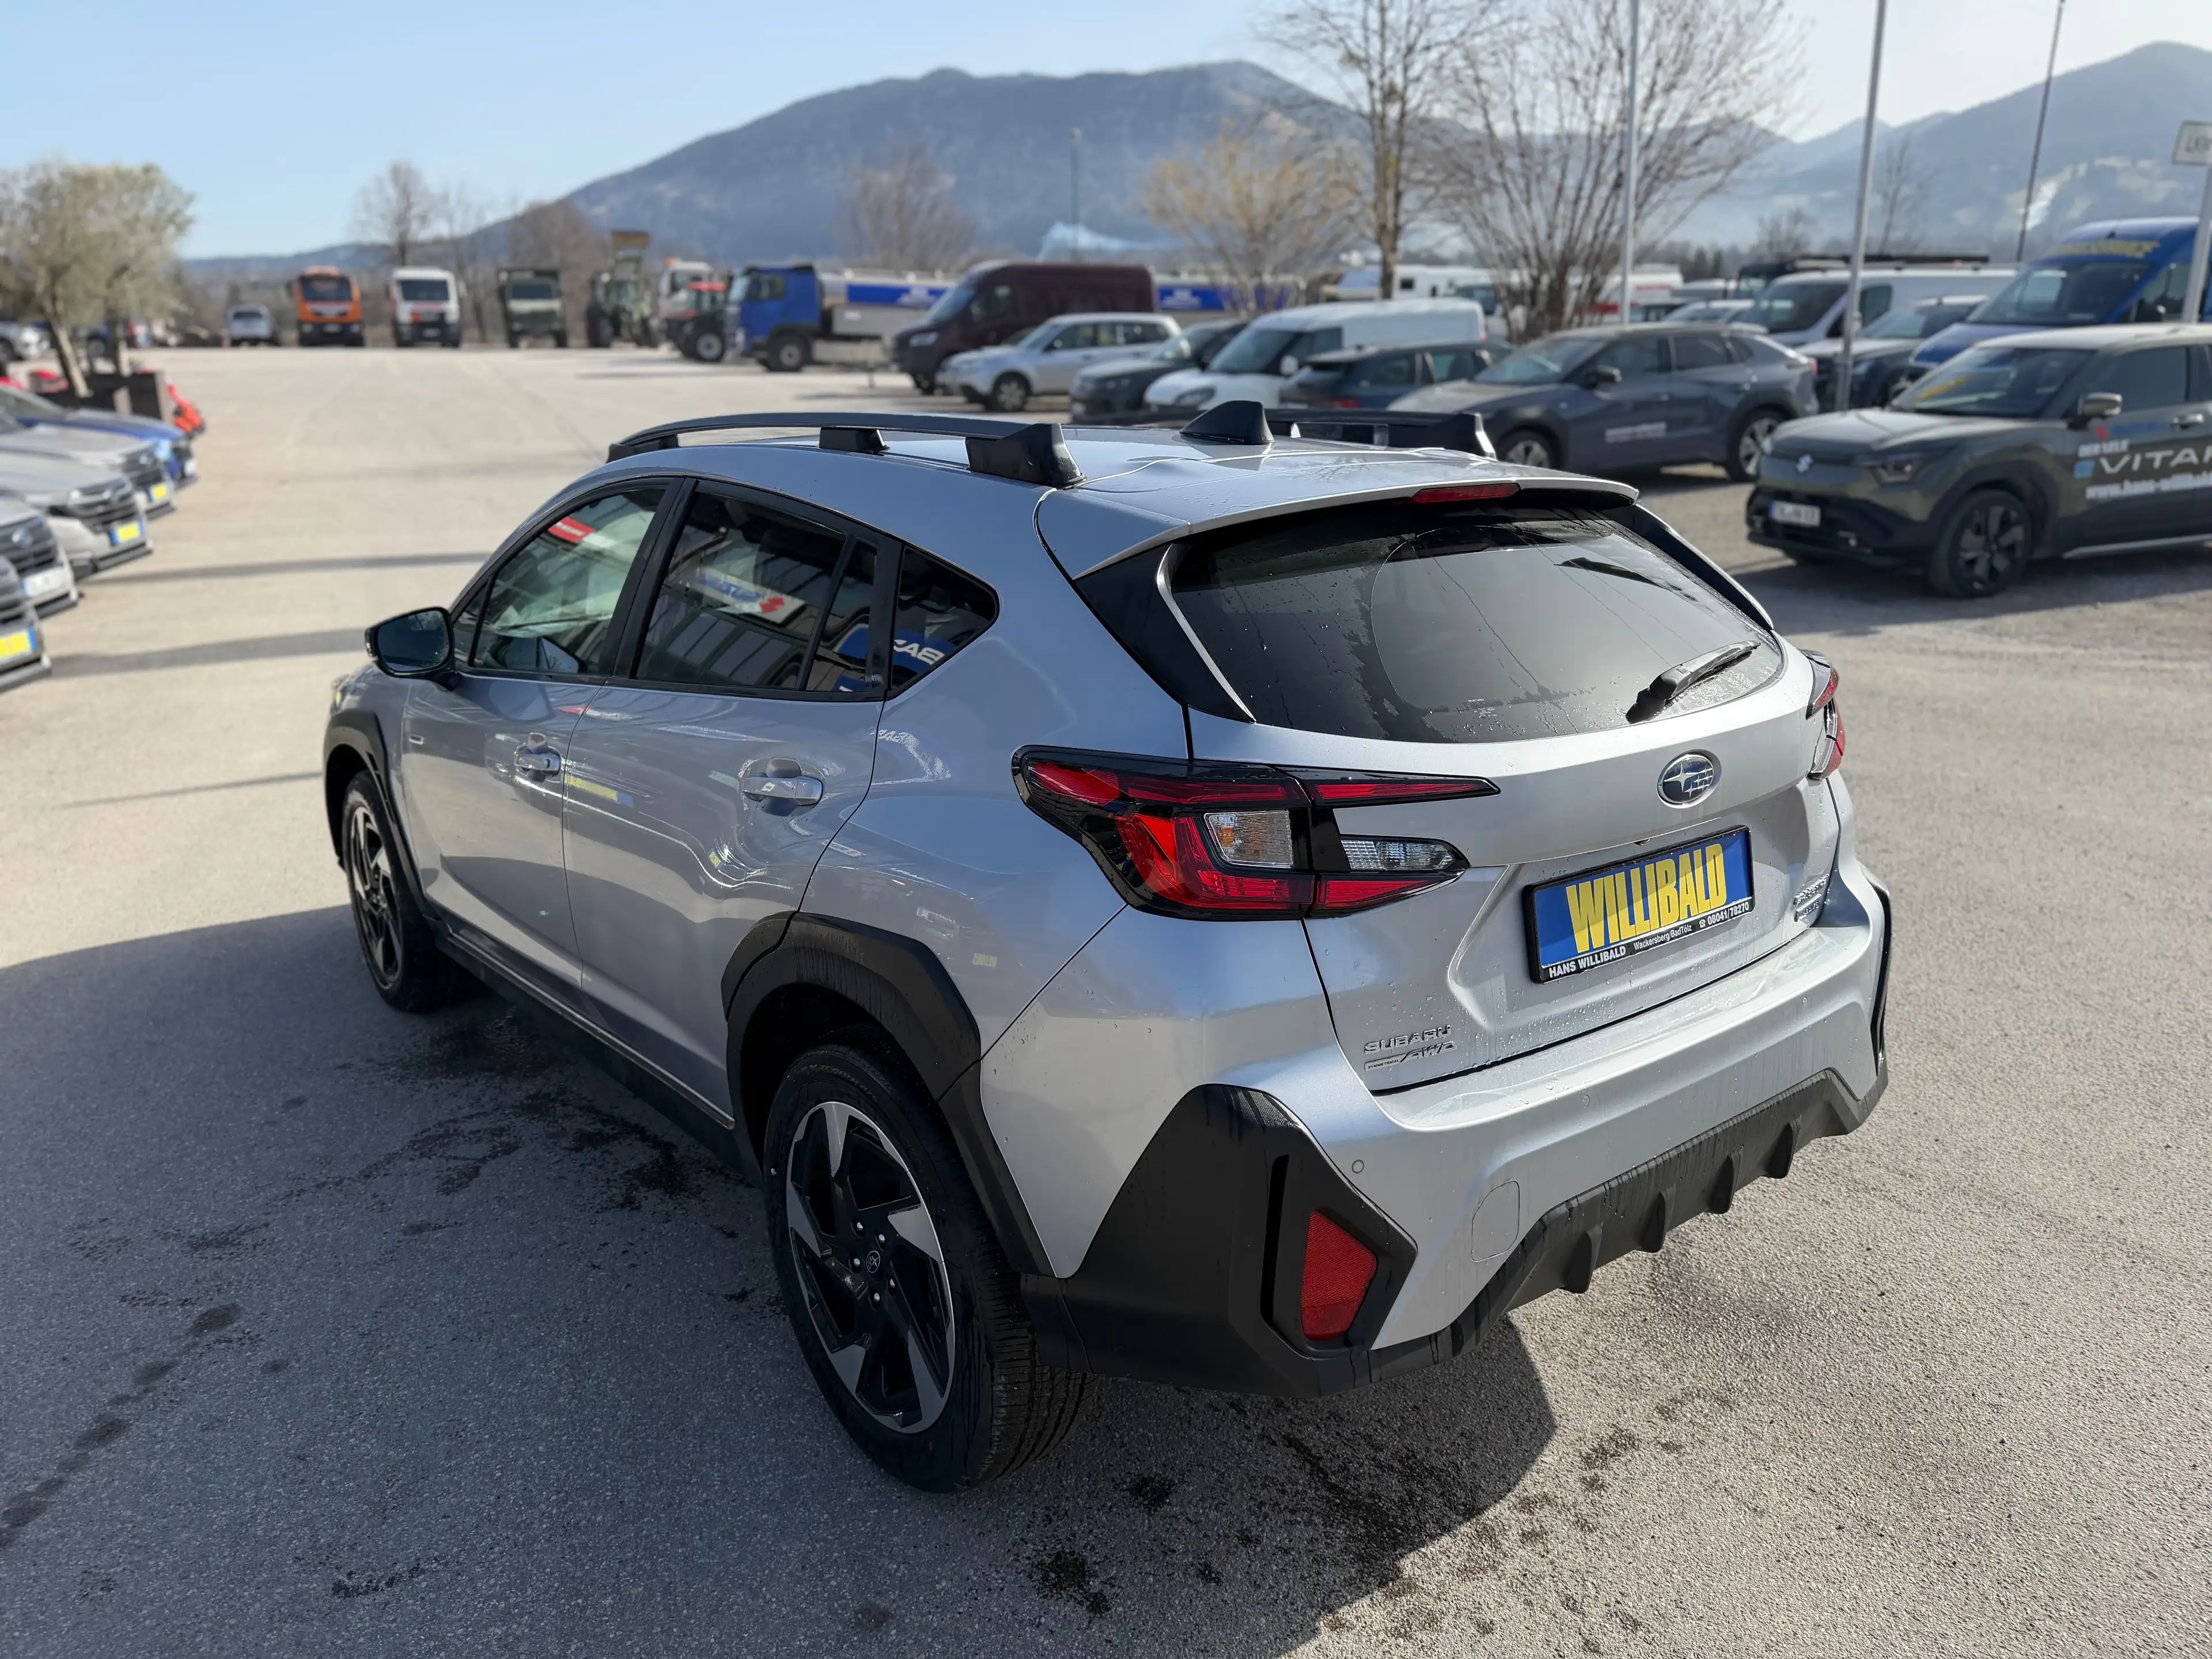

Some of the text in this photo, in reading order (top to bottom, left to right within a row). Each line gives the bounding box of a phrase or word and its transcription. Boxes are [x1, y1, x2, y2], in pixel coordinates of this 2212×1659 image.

[1566, 843, 1727, 953] WILLIBALD
[1549, 961, 1577, 979] HANS
[1577, 946, 1626, 969] WILLIBALD
[1707, 901, 1749, 925] 08041/78270
[1365, 1025, 1452, 1055] SUBARU
[1368, 1040, 1457, 1069] SYMMETRICAL AWD
